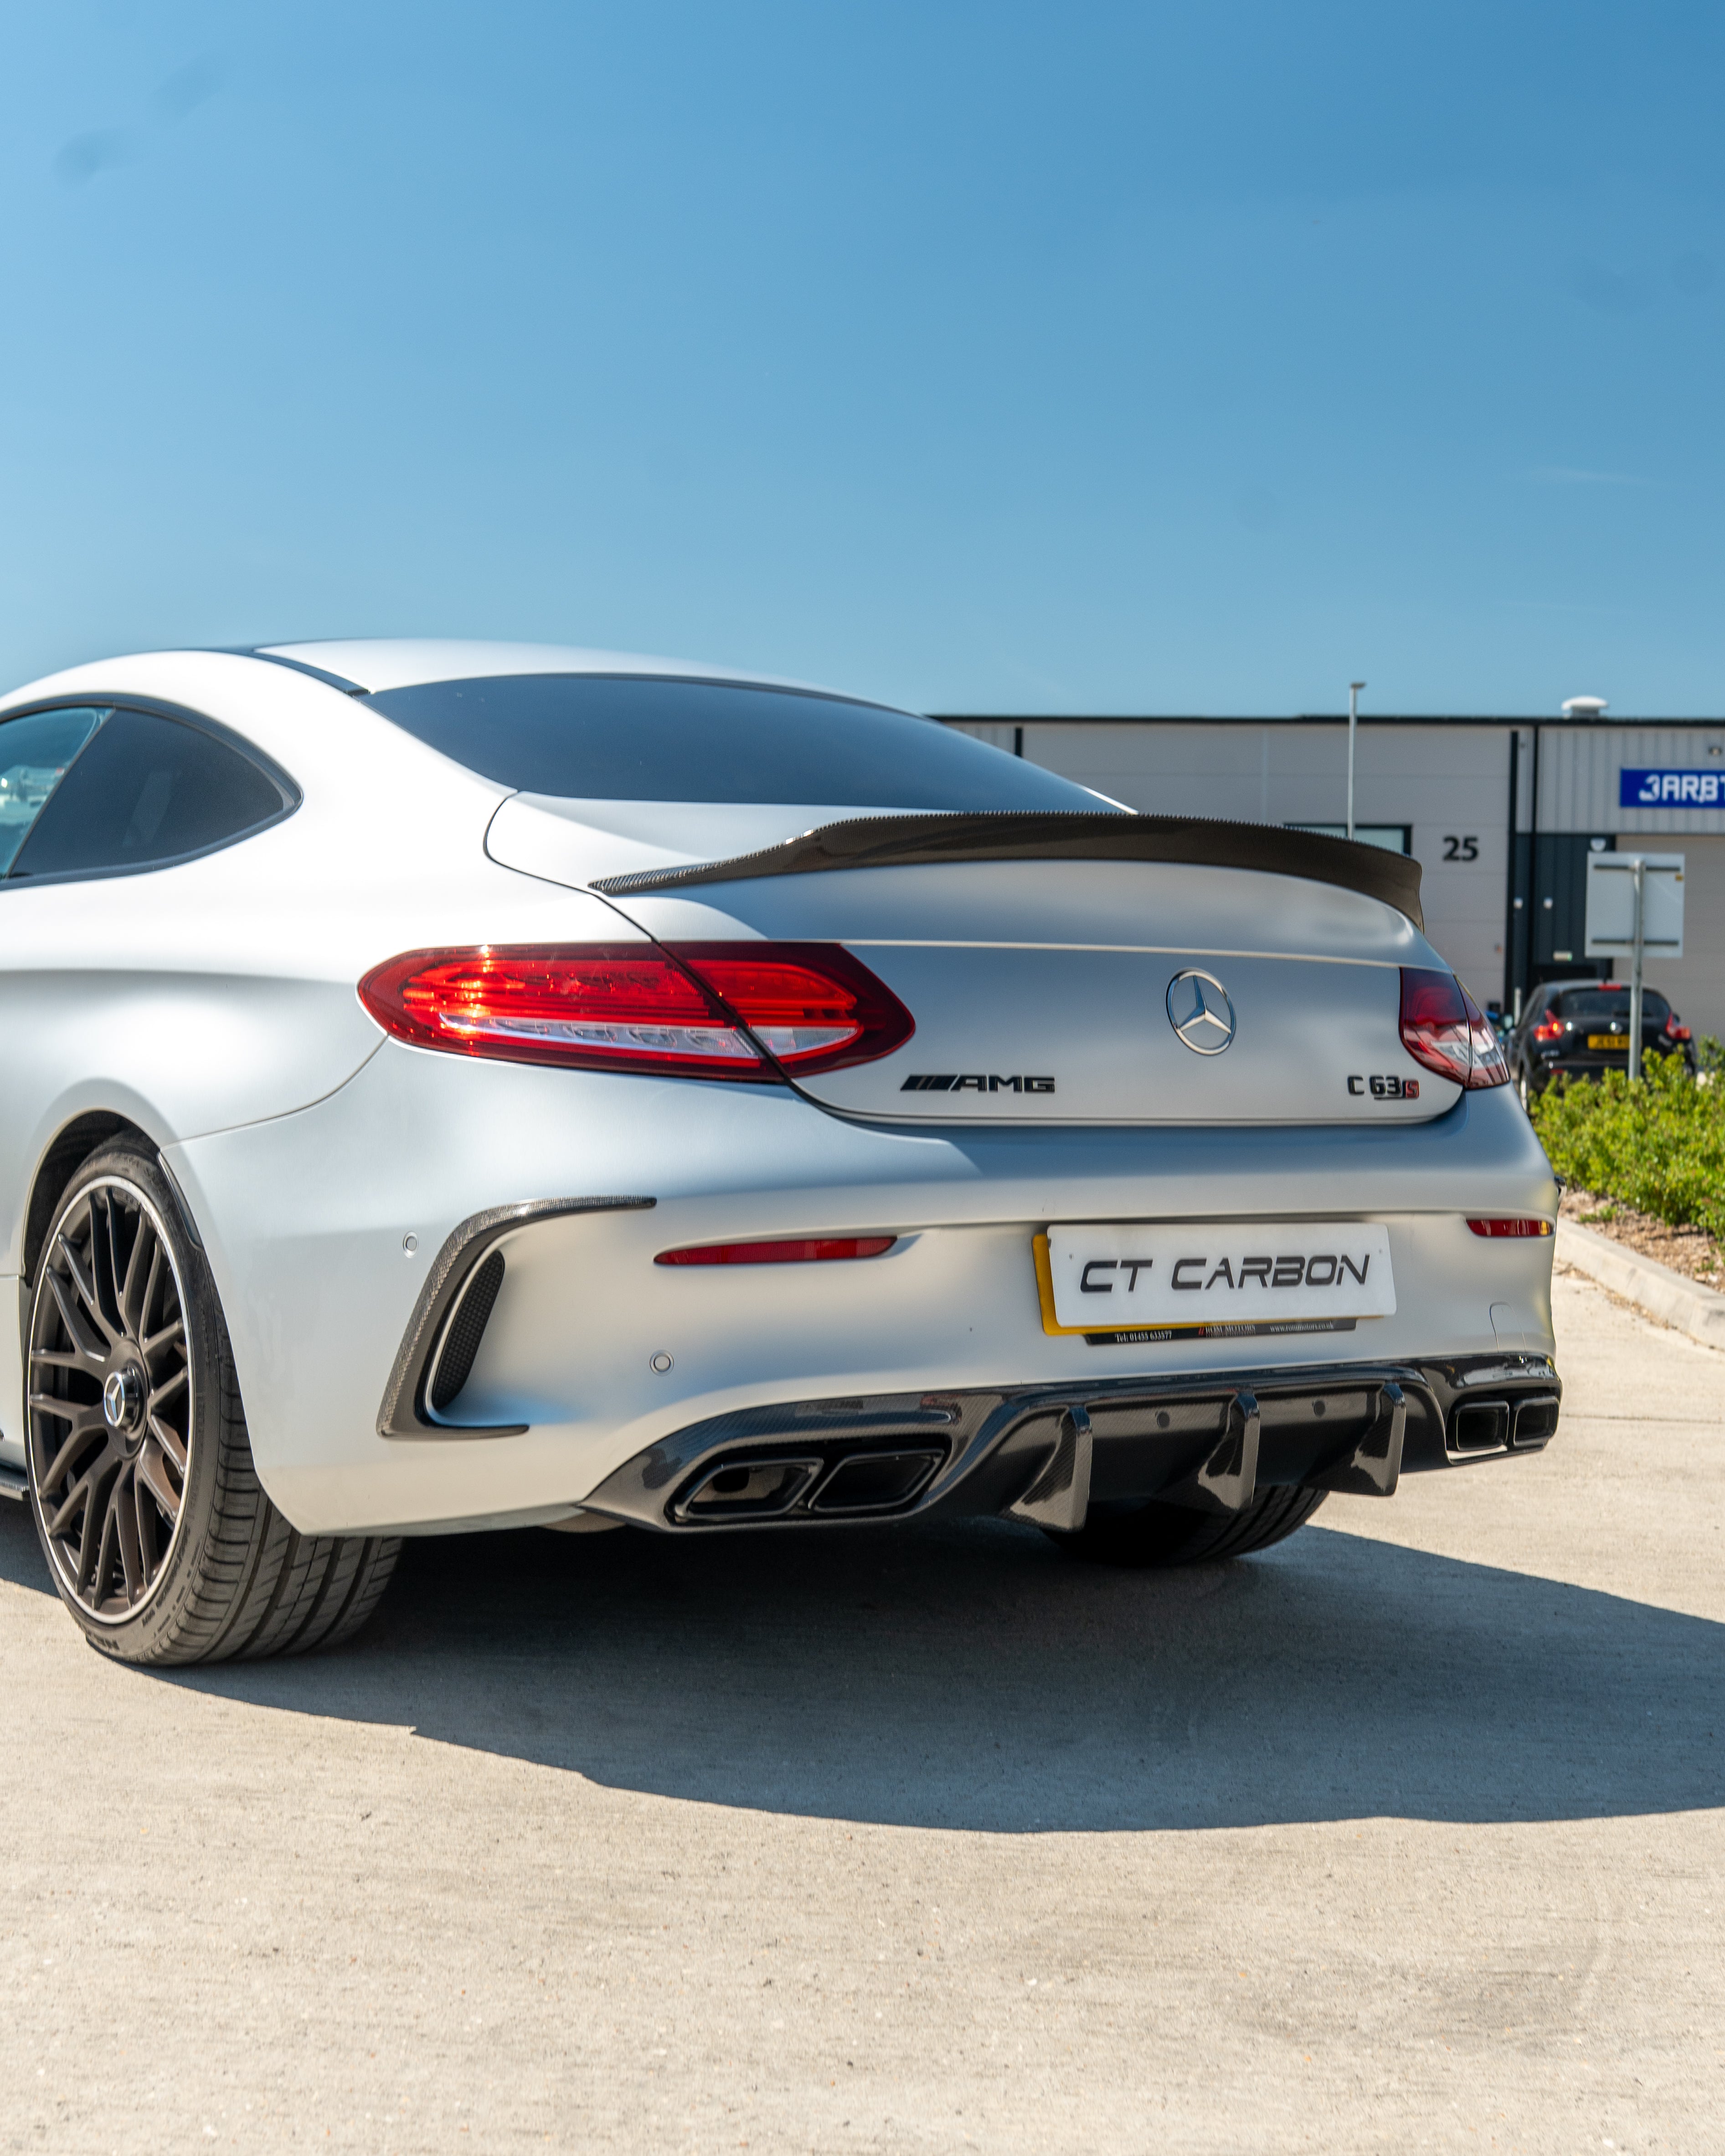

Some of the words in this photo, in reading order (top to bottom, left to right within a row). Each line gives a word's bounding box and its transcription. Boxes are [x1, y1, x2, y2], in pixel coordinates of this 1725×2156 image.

[1442, 835, 1479, 861] 25
[950, 1075, 1055, 1093] AMG
[1080, 1259, 1153, 1293] CT
[1171, 1254, 1370, 1290] CARBON
